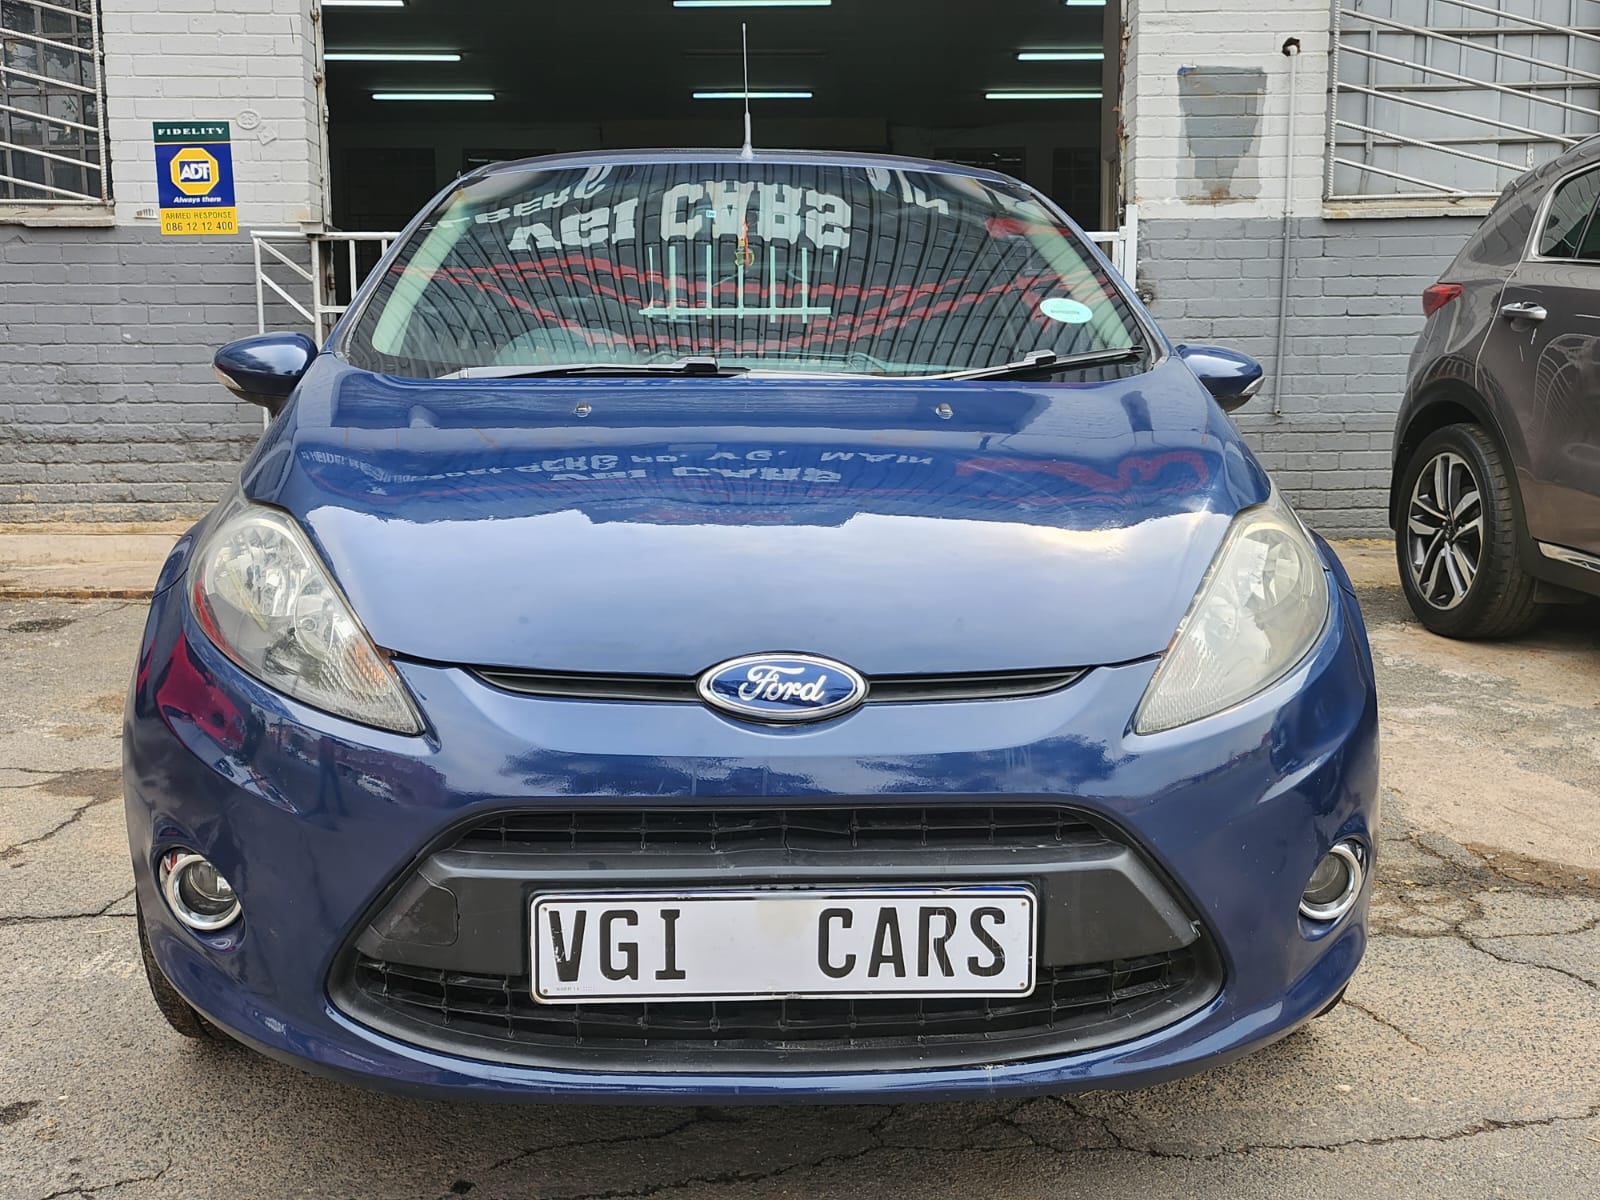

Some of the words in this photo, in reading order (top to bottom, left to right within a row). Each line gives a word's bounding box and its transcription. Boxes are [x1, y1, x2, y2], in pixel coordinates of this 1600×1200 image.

[157, 127, 225, 136] FIDELITY
[180, 162, 210, 180] ADT
[173, 196, 200, 204] Always
[165, 212, 192, 220] ARMED
[193, 211, 232, 219] RESPONSE
[166, 222, 183, 231] 086
[186, 222, 198, 231] 12
[201, 221, 213, 230] 12
[216, 221, 233, 230] 400
[738, 665, 827, 702] Ford
[549, 909, 687, 982] VGI
[818, 906, 1006, 979] CARS
